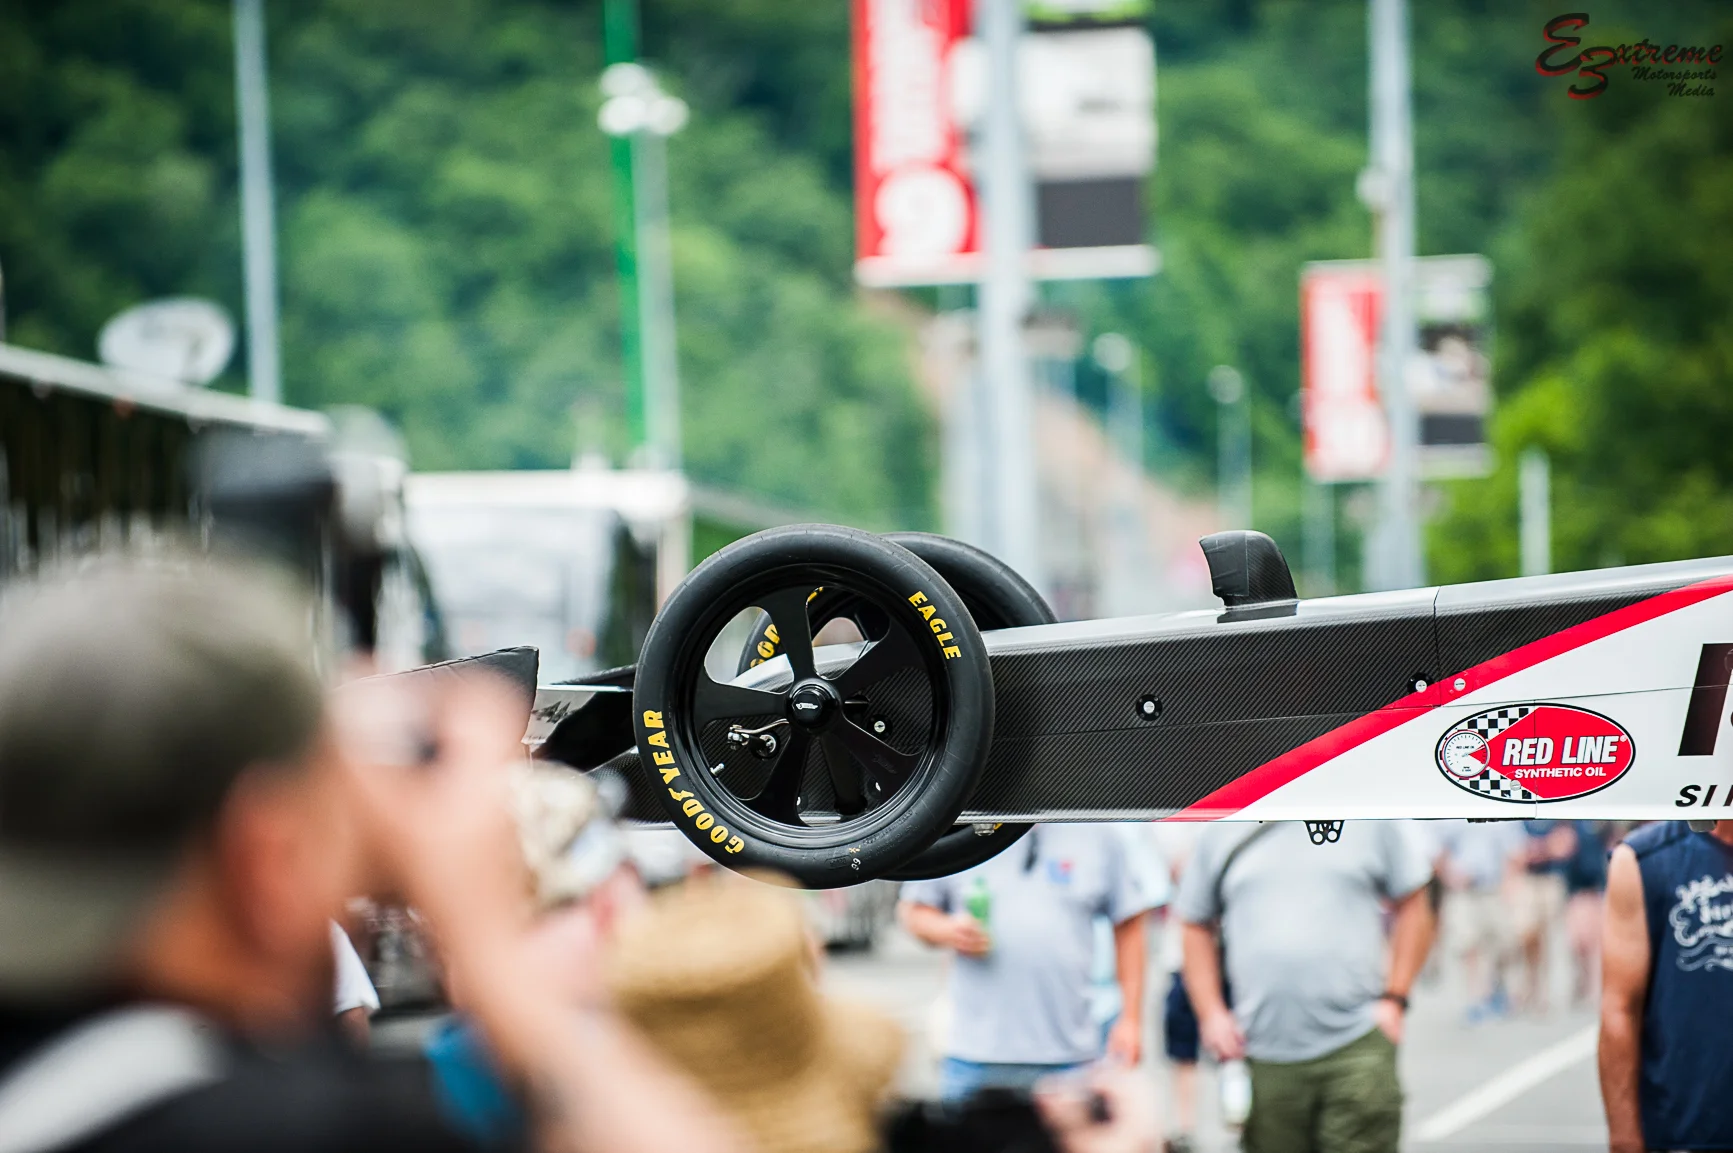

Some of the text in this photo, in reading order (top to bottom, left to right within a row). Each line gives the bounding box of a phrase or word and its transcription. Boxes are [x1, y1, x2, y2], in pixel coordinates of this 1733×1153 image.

[908, 590, 962, 660] EAGLE
[1502, 735, 1619, 766] RED LINE
[1514, 766, 1607, 779] SYNTHETIC OIL
[643, 709, 745, 854] GOODYEAR
